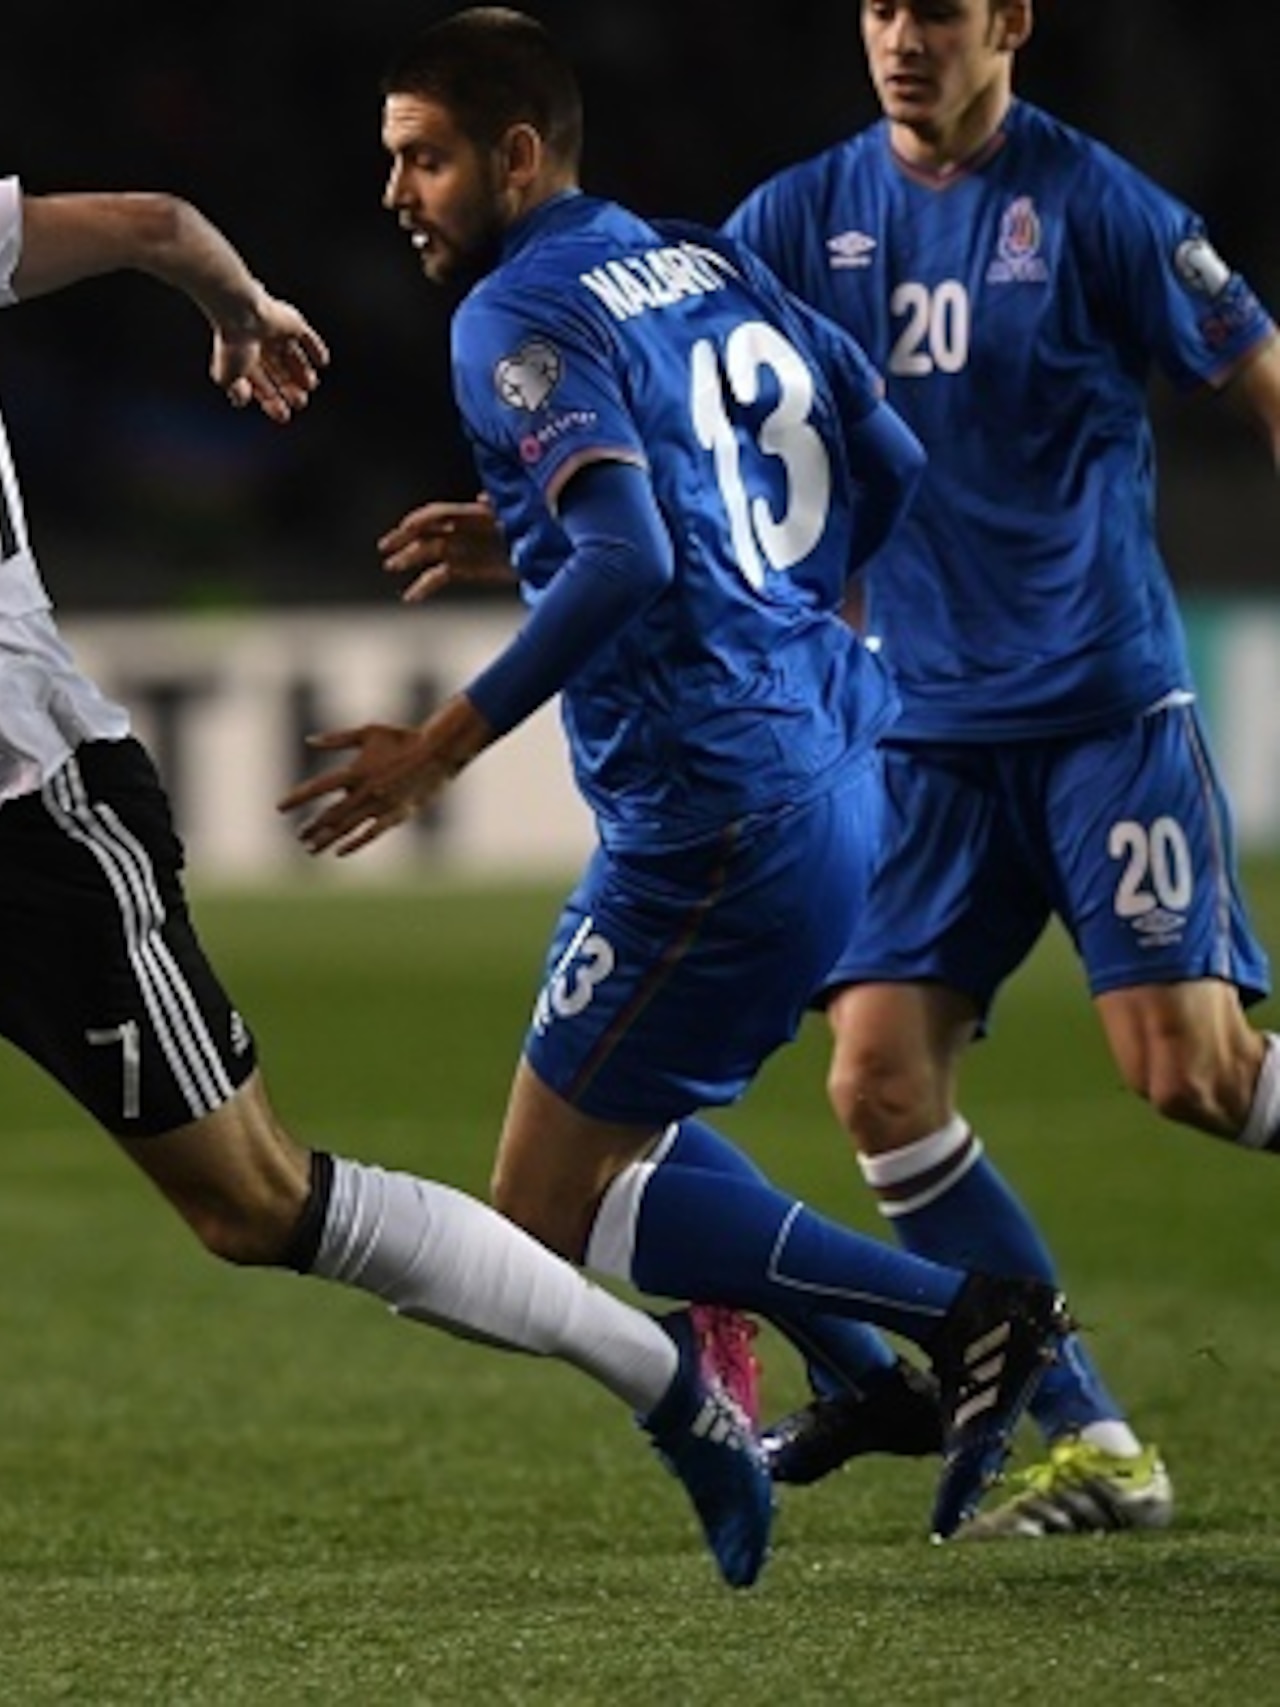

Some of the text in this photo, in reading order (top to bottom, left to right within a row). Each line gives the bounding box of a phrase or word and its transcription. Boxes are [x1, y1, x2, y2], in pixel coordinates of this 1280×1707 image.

[889, 279, 970, 377] 20
[690, 320, 832, 592] 13
[1108, 815, 1194, 917] 20
[85, 1019, 141, 1119] 7
